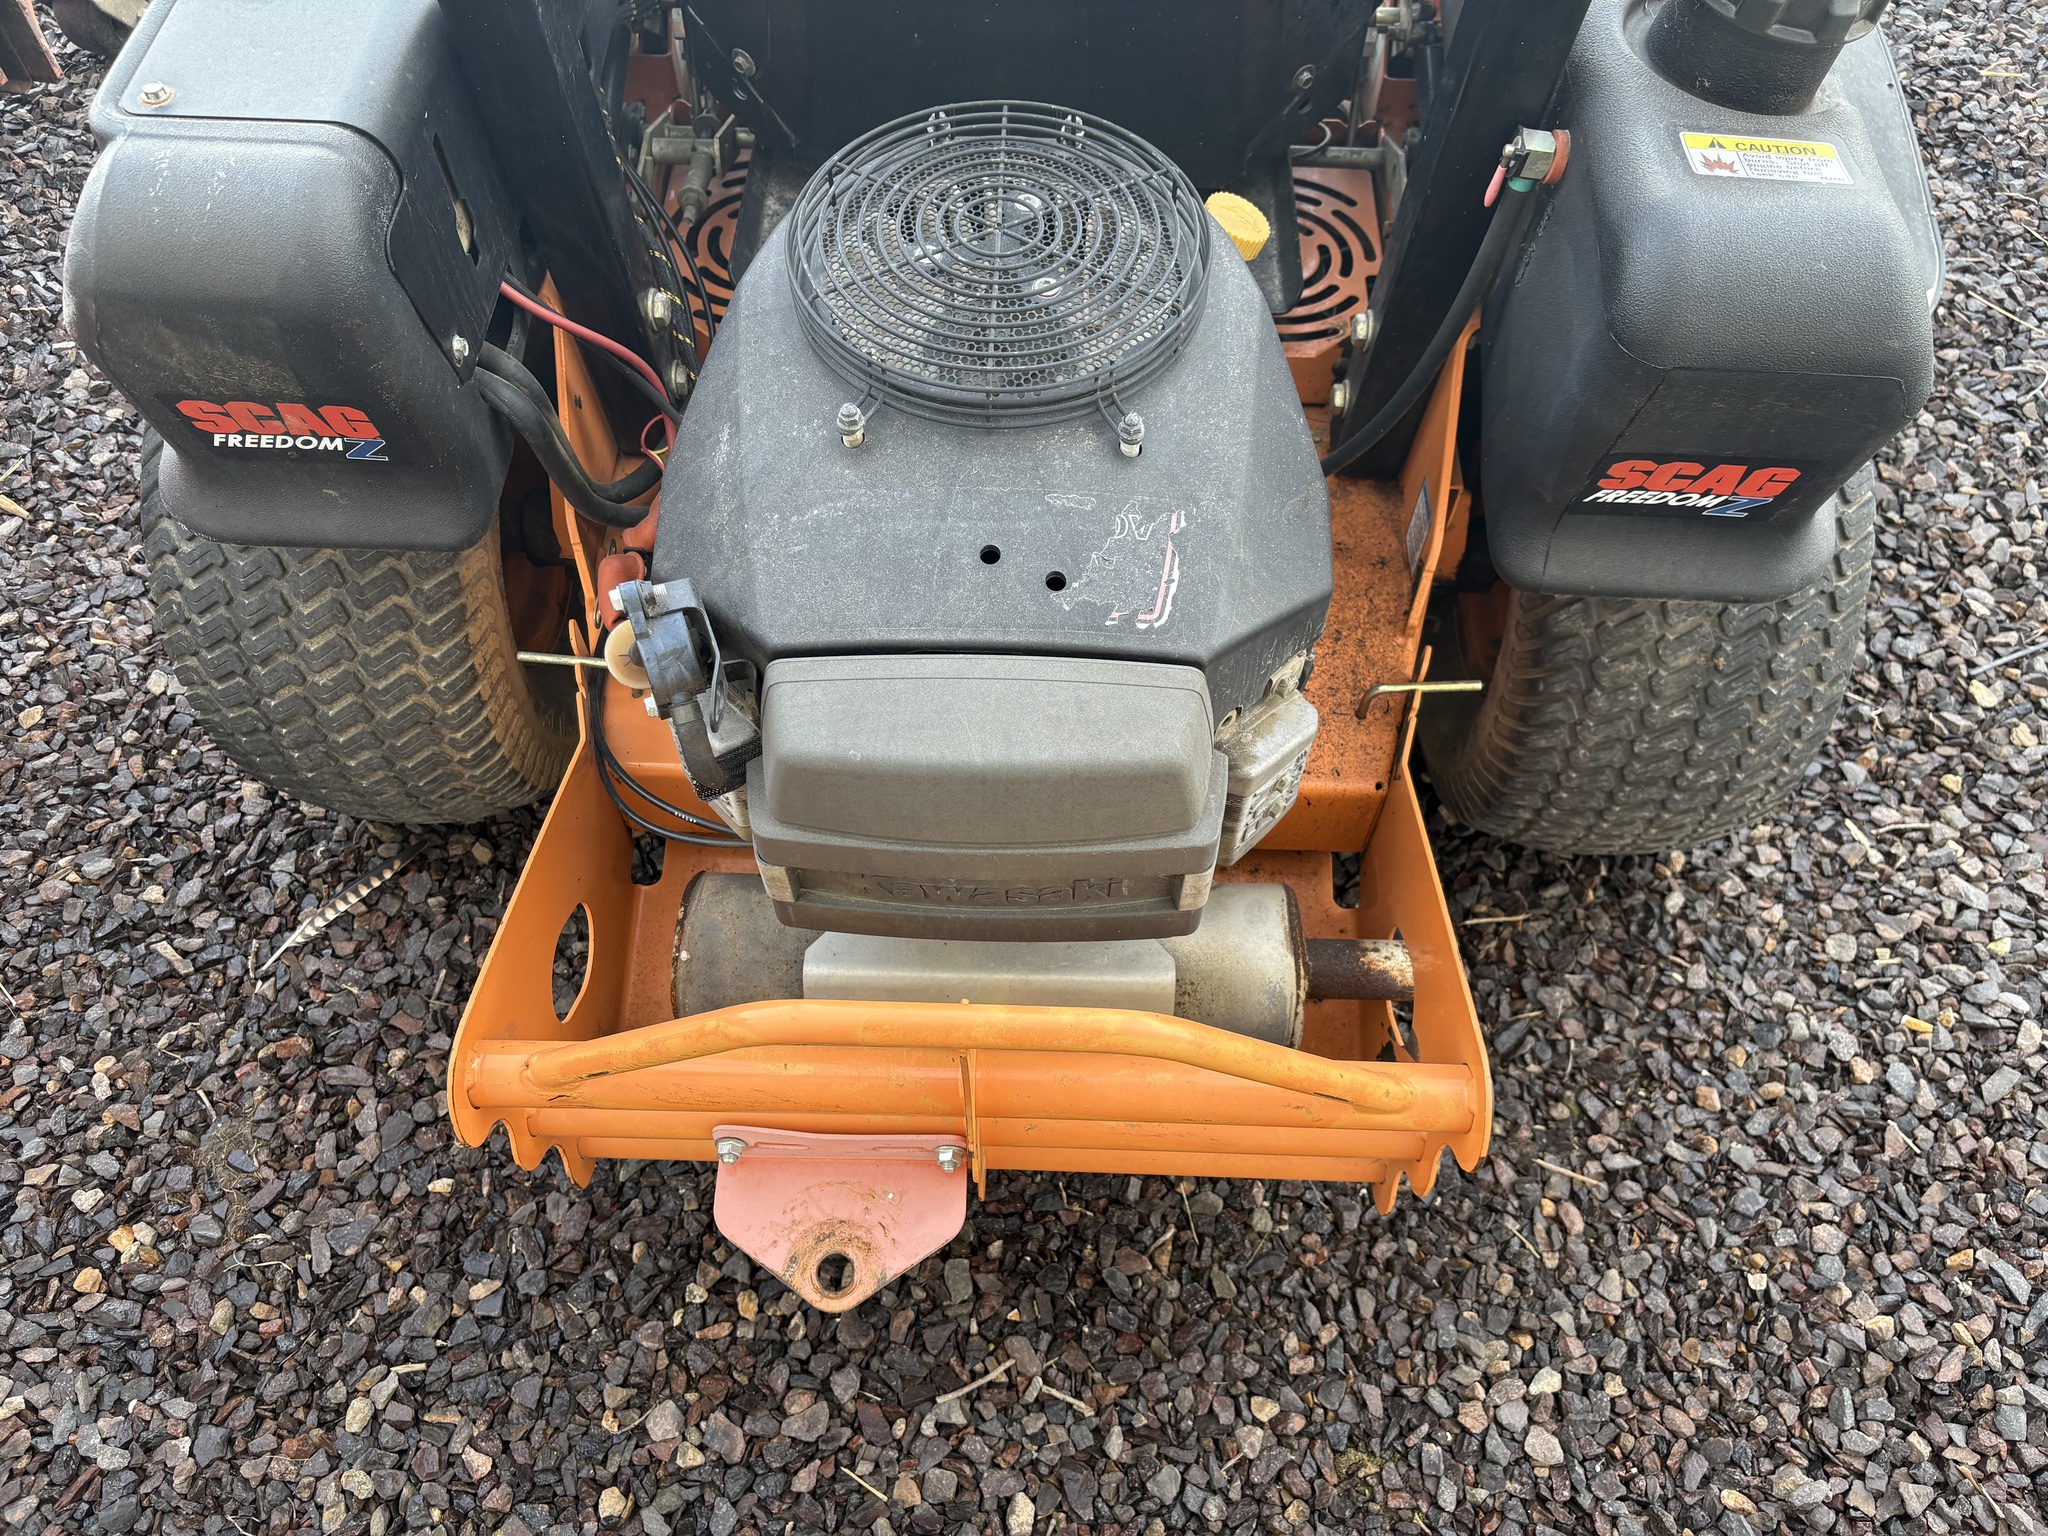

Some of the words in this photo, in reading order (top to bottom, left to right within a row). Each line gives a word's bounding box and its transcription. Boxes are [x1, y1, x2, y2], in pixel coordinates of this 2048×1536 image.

[1735, 142, 1817, 156] CAUTION
[175, 400, 381, 439] SCAG
[1596, 459, 1801, 498] SCAG
[861, 874, 1128, 904] Kawasaki
